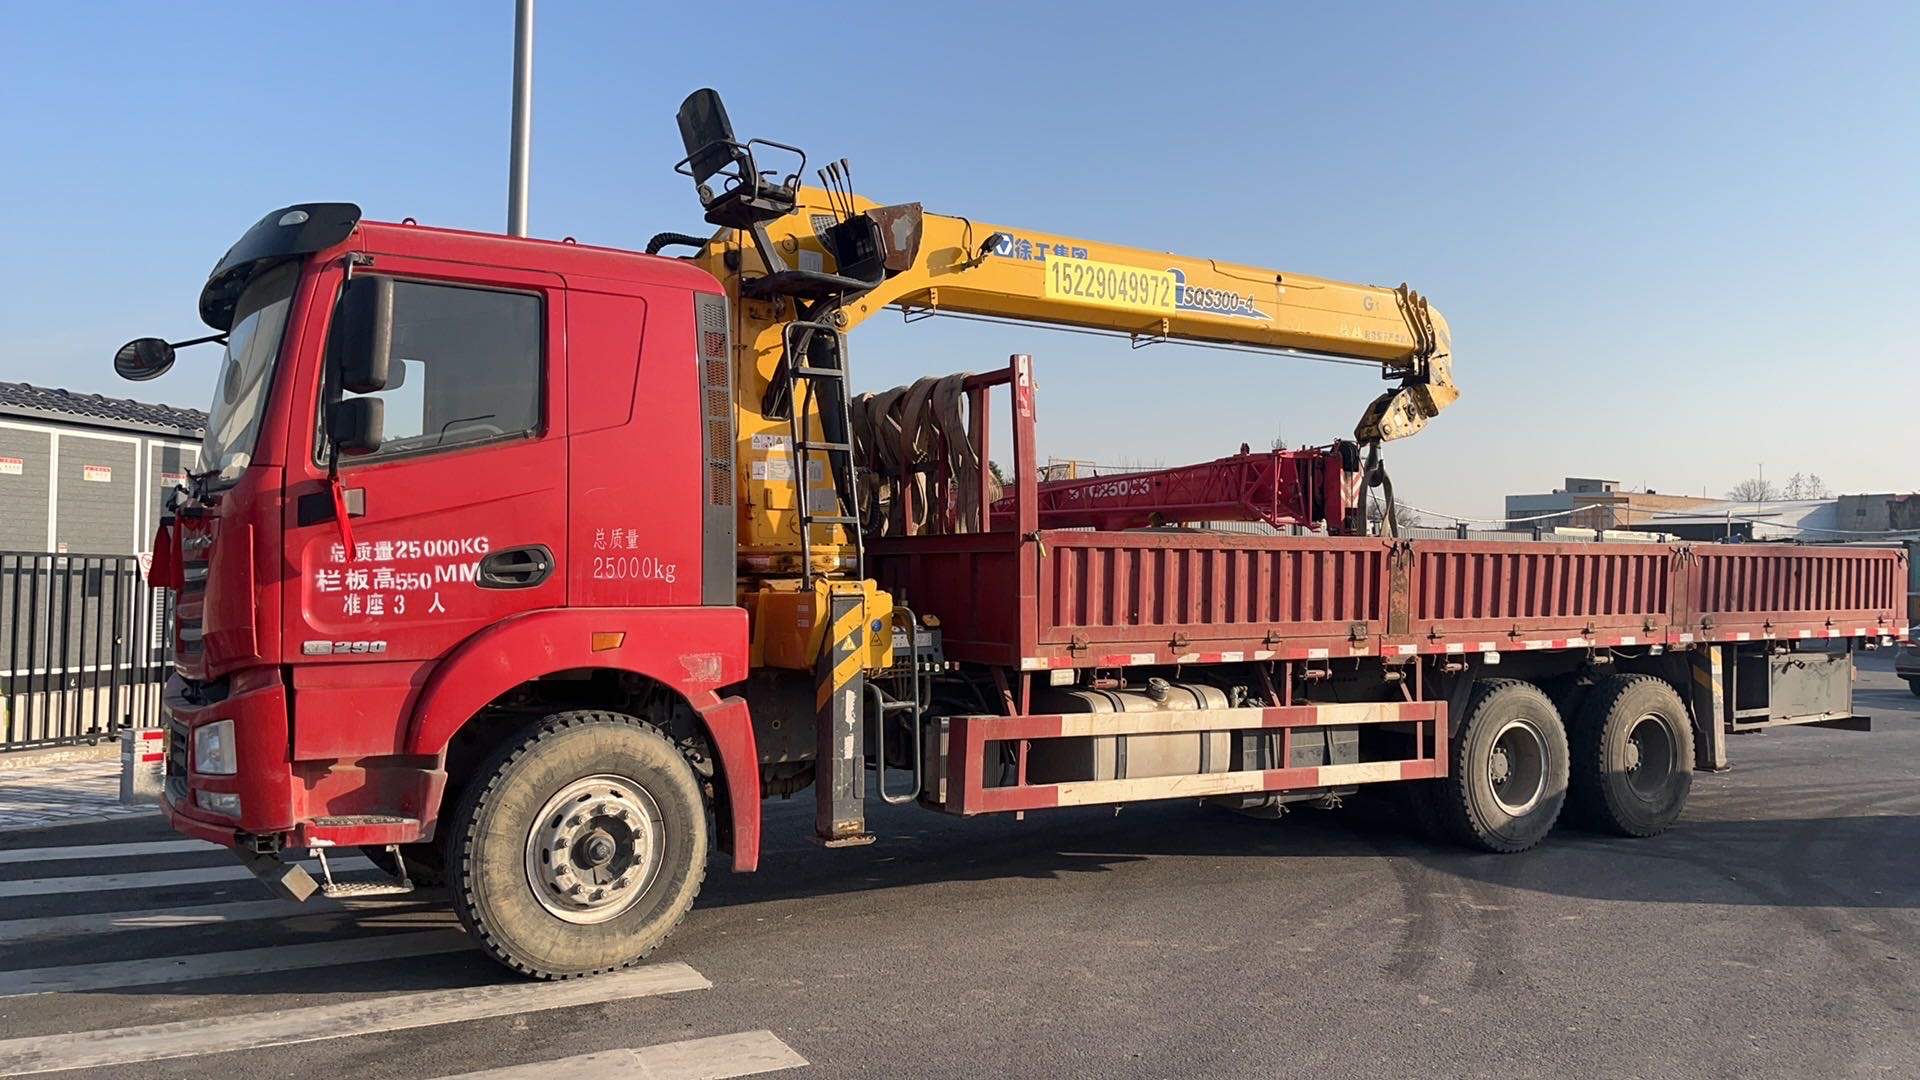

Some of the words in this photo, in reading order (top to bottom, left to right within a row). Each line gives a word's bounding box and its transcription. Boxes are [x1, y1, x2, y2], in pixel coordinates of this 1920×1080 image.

[1052, 261, 1170, 307] 15229049972
[1184, 286, 1254, 313] SQS300-4
[593, 527, 639, 550] 总质量
[593, 556, 676, 583] 25000kg
[333, 640, 387, 654] 290
